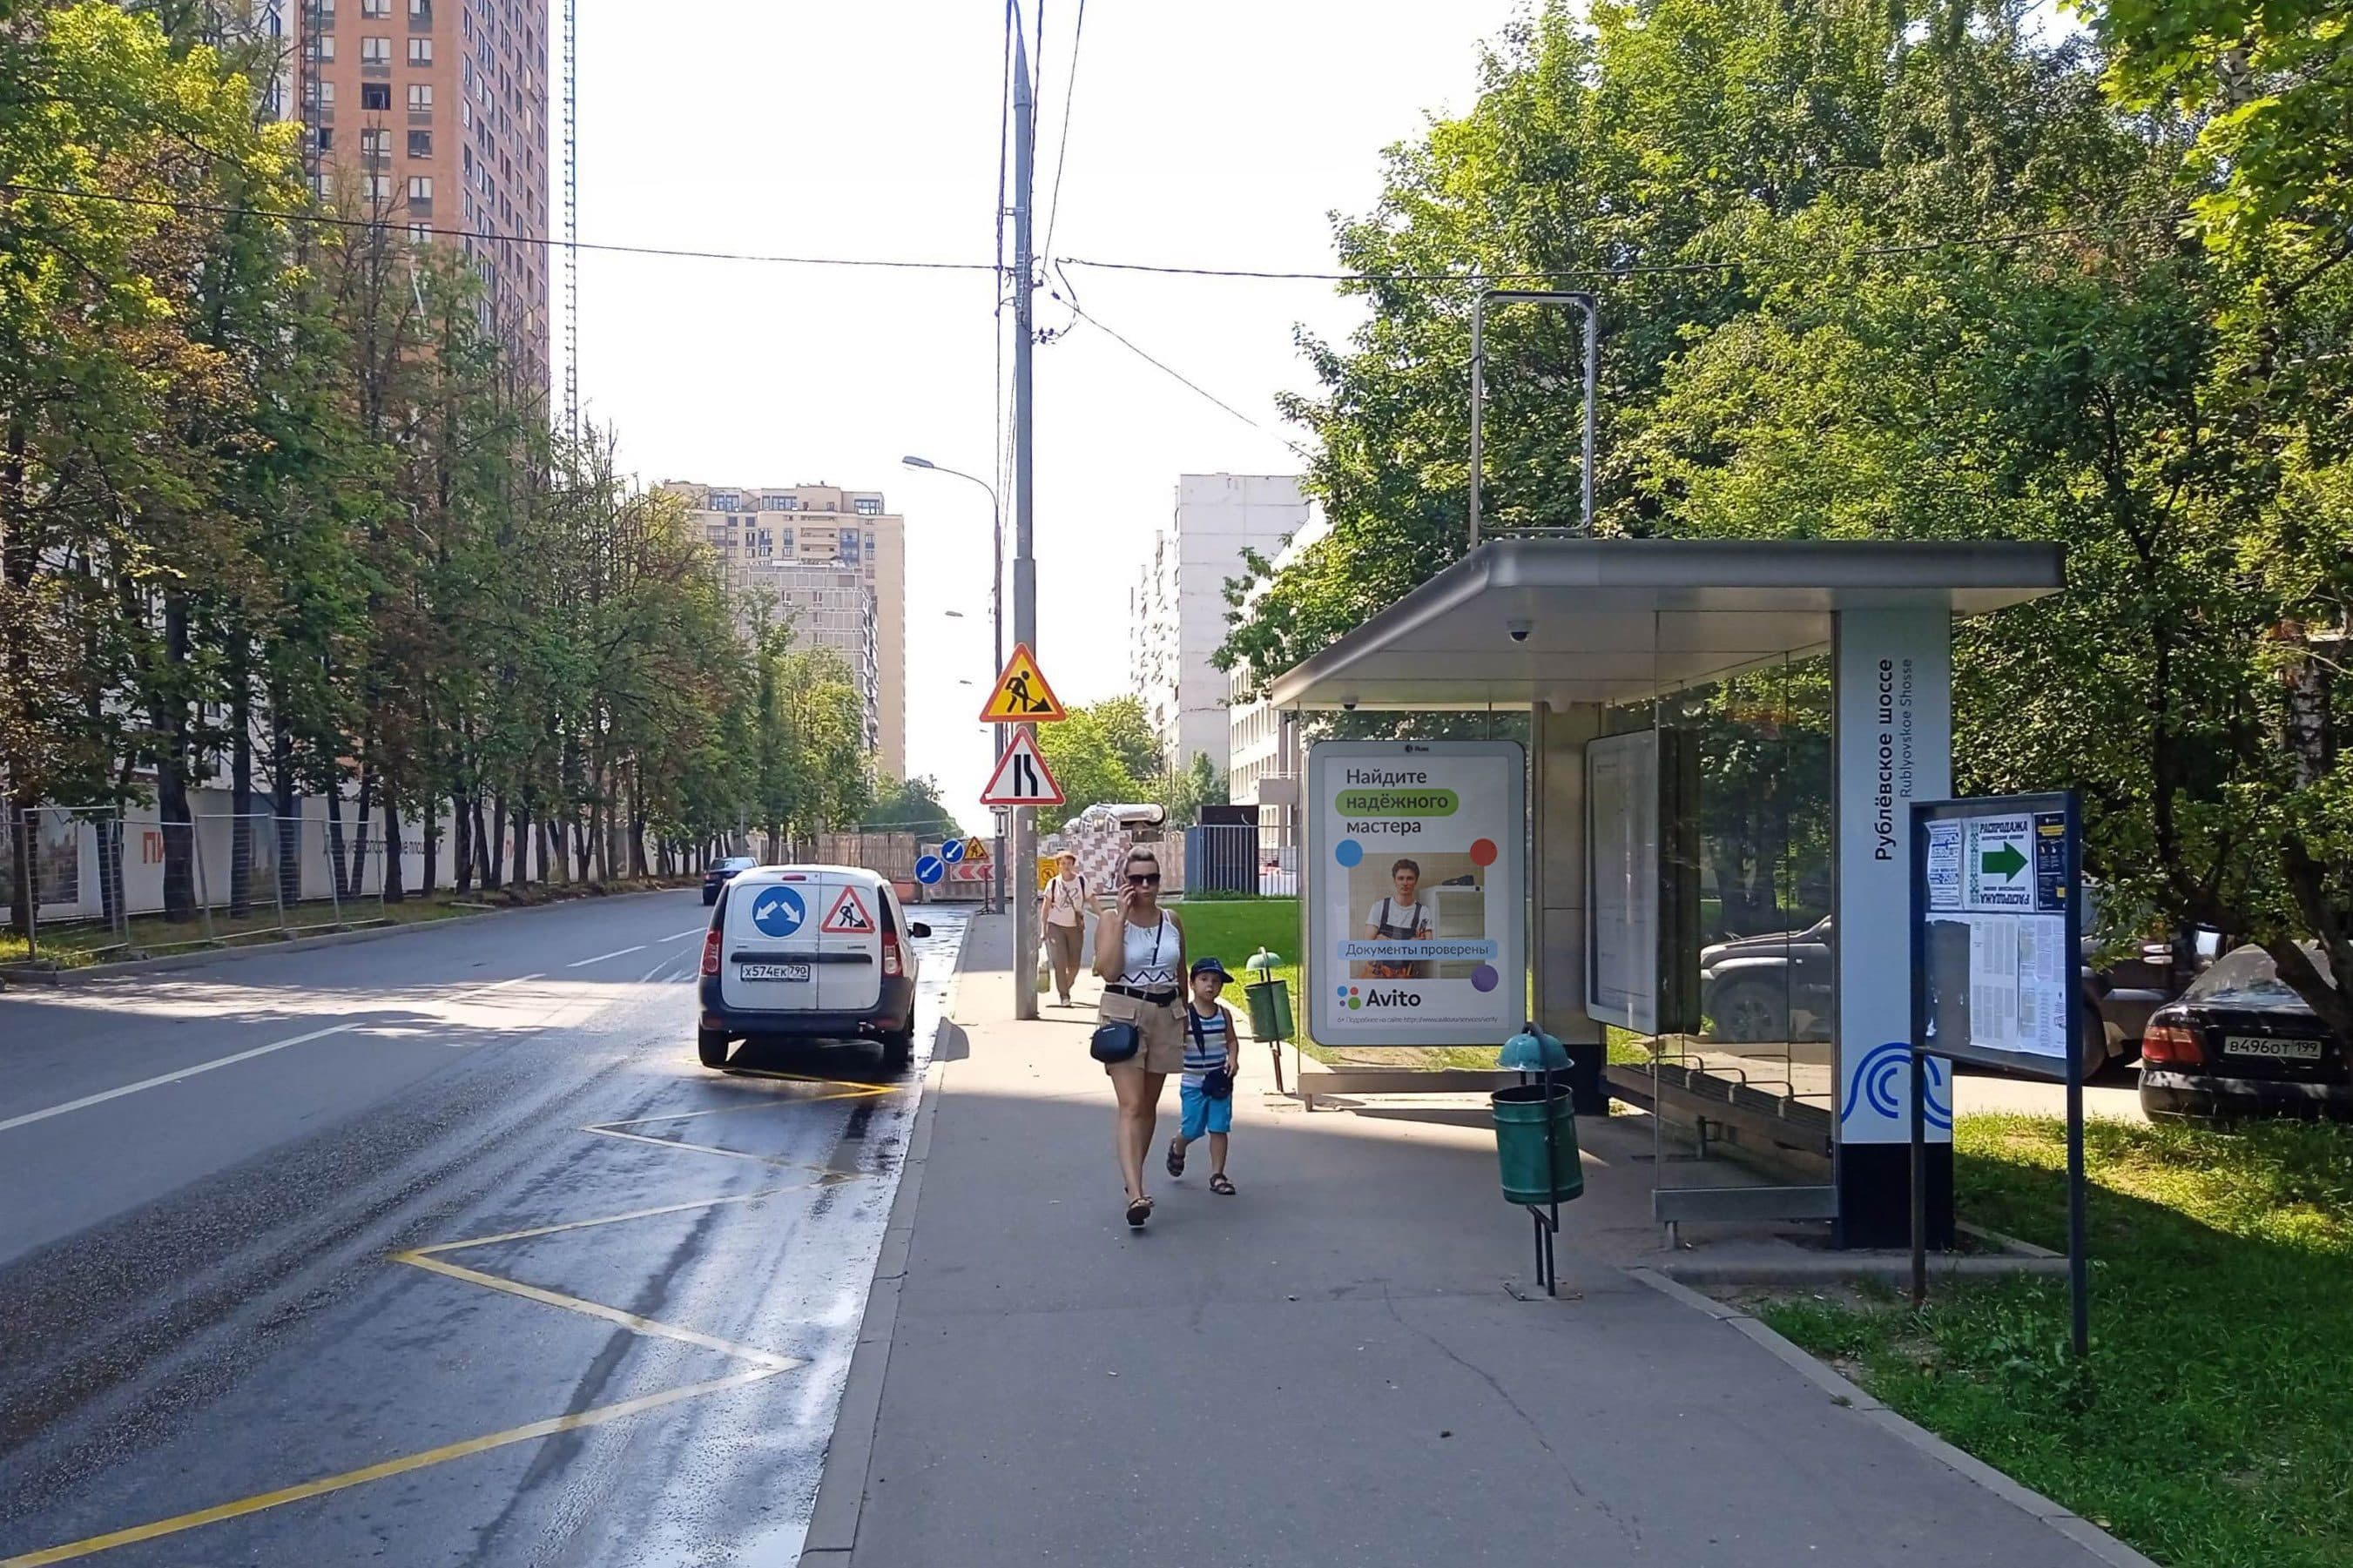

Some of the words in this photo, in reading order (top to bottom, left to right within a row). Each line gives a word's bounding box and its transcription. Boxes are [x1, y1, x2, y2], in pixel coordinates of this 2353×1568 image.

[1879, 658, 1893, 724] шоссе
[1899, 658, 1912, 706] Shosse
[1899, 711, 1913, 798] Rublyovskoe
[1346, 768, 1427, 788] Найдите
[1346, 793, 1448, 812] надёжного
[1875, 733, 1897, 860] Рублёвское
[1346, 821, 1421, 836] мастера
[1979, 821, 2028, 834] РАСПРОДАЖА
[1345, 944, 1418, 957] Документы
[1420, 946, 1489, 957] проверены
[789, 966, 807, 975] 790
[1365, 988, 1421, 1006] Avito
[2229, 1040, 2289, 1055] В496ОТ
[2295, 1041, 2318, 1053] 199
